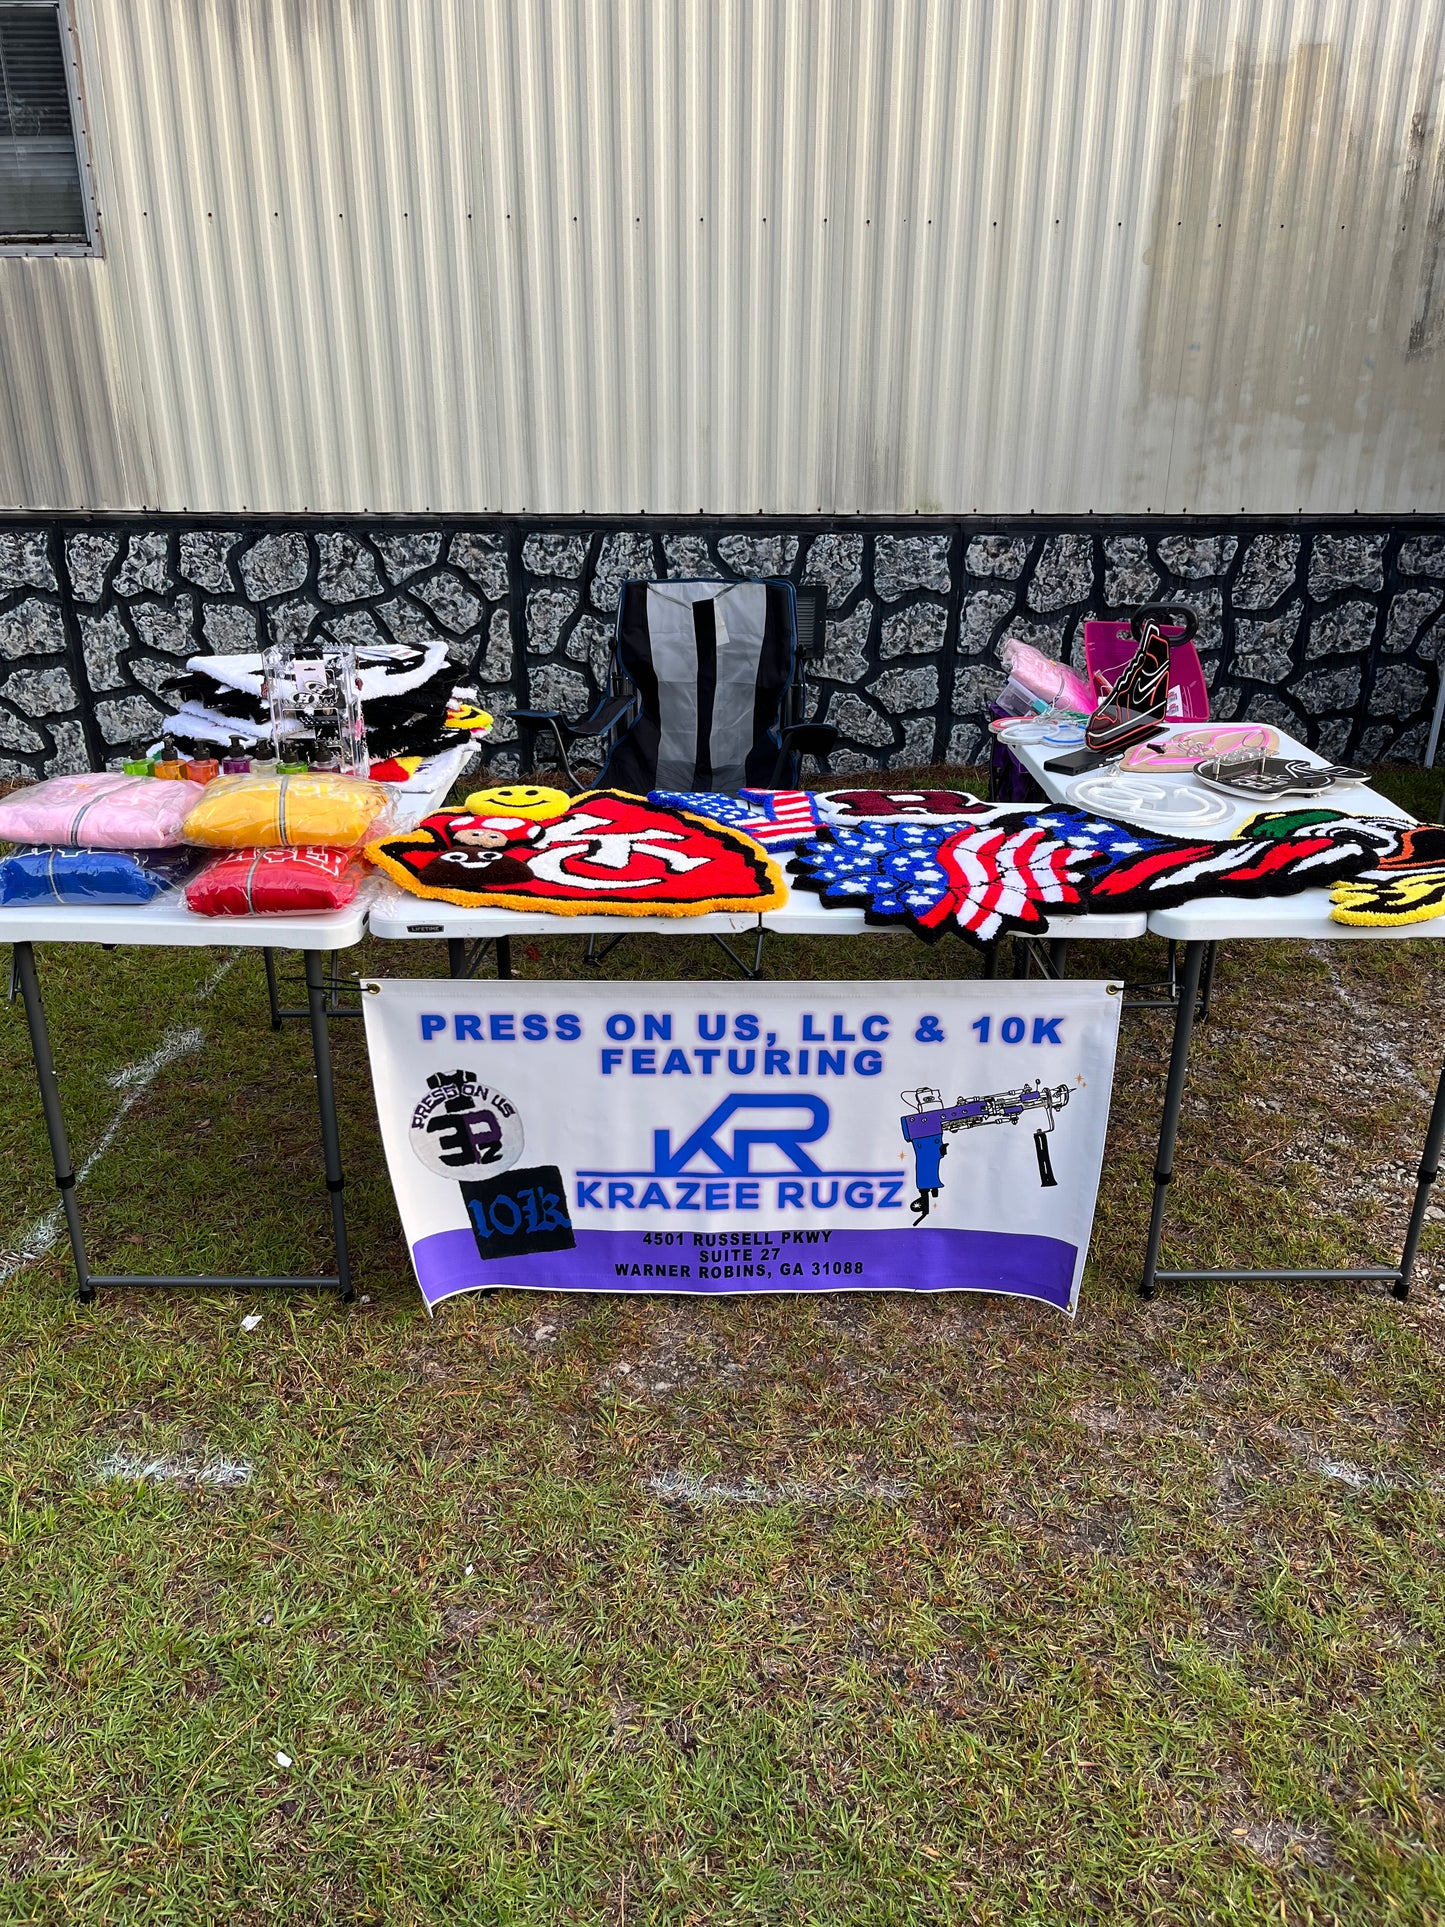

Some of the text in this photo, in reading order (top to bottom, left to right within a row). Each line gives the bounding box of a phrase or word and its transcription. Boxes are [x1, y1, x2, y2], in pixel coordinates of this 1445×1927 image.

[420, 1014, 1064, 1047] PRESS ON US, LLC & 10K
[601, 1049, 883, 1076] FEATURING
[411, 1083, 516, 1130] PRESS ON US
[654, 1093, 830, 1176] KR
[577, 1181, 903, 1211] KRAZEE RUGZ
[642, 1230, 833, 1247] 4501 RUSSELL PKWY
[699, 1247, 781, 1263] SUITE 27
[614, 1261, 864, 1279] WARNER ROBINS, GA 31088
